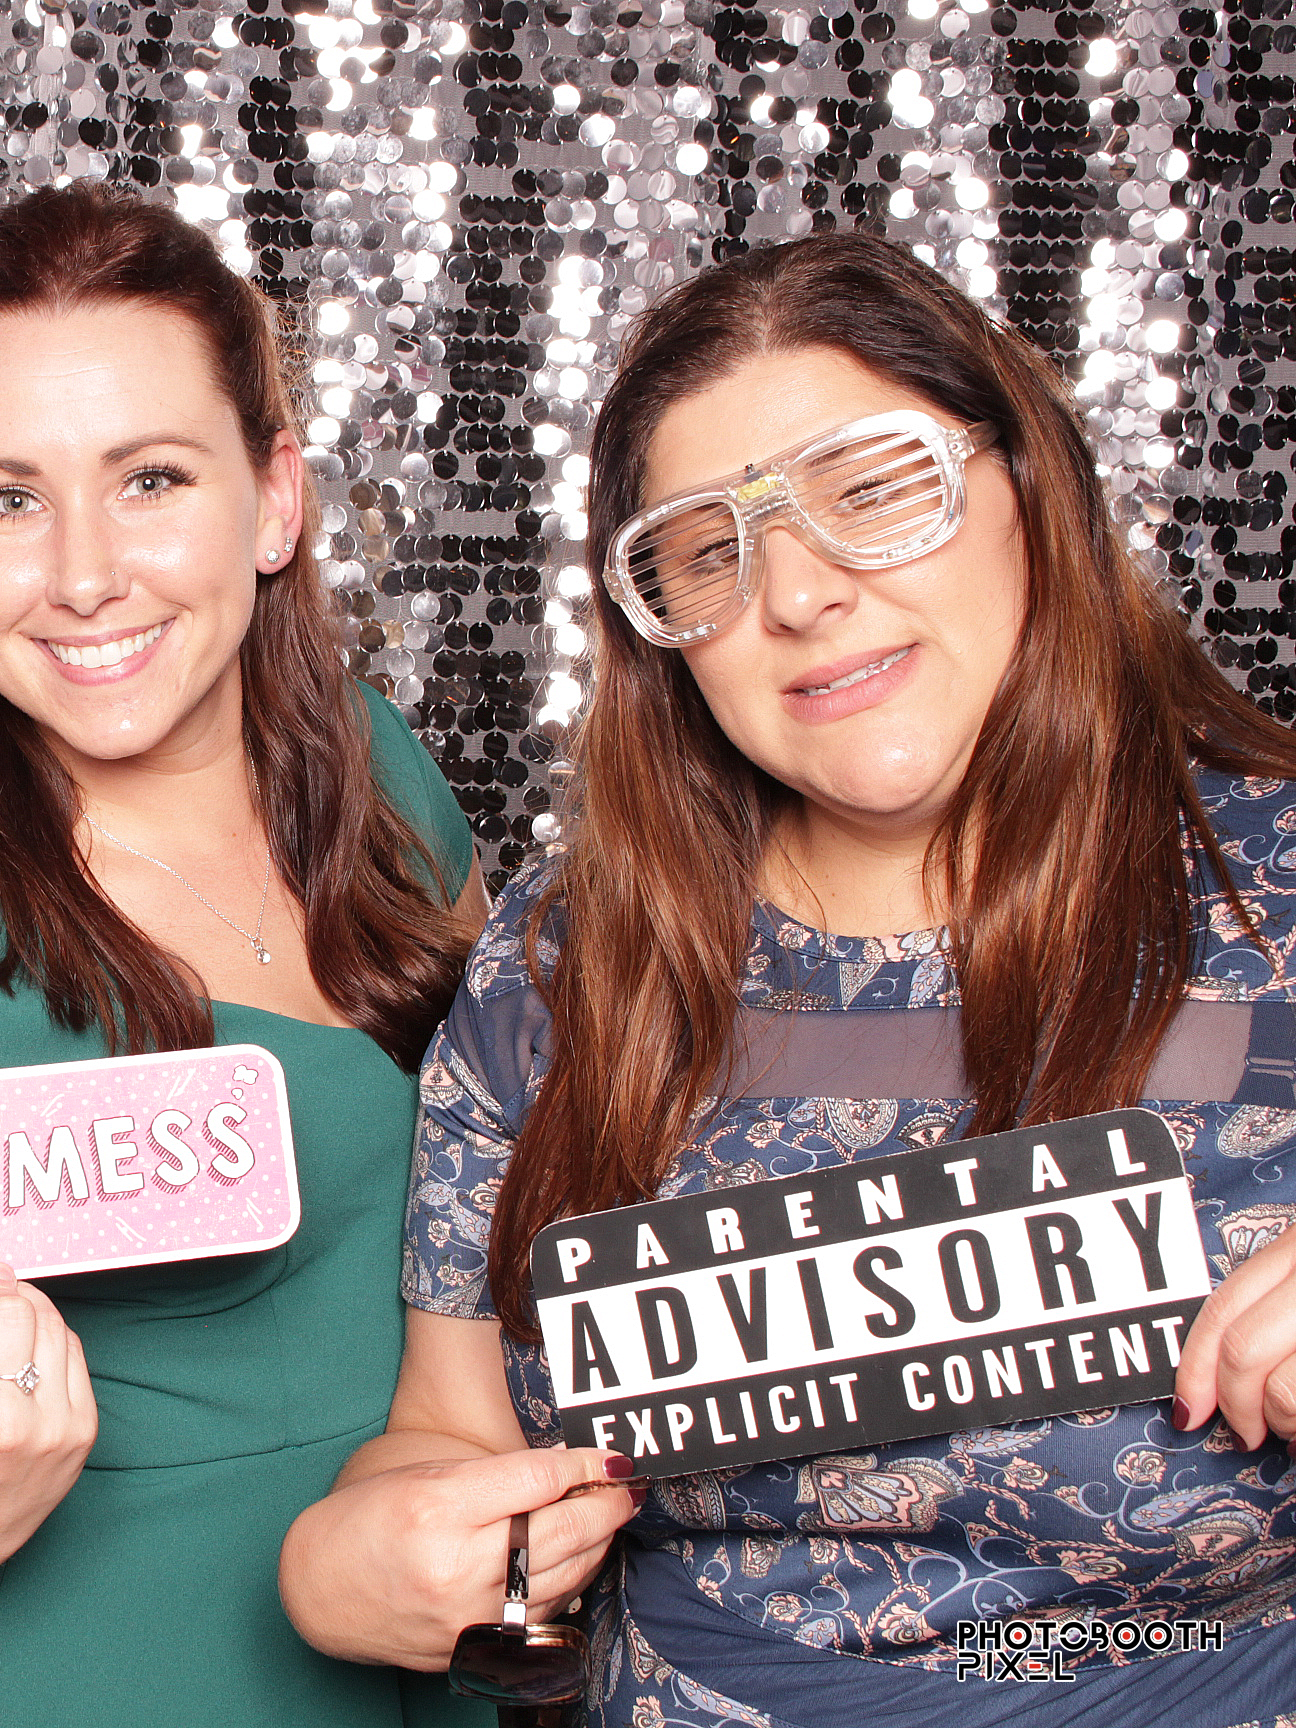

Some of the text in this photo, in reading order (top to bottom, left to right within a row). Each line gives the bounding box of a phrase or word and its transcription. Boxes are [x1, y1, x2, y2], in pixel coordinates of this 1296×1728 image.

[3, 1101, 256, 1216] MESS
[556, 1128, 1148, 1284] PARENTAL
[571, 1190, 1171, 1395] ADVISORY
[902, 1315, 1185, 1413] CONTENT
